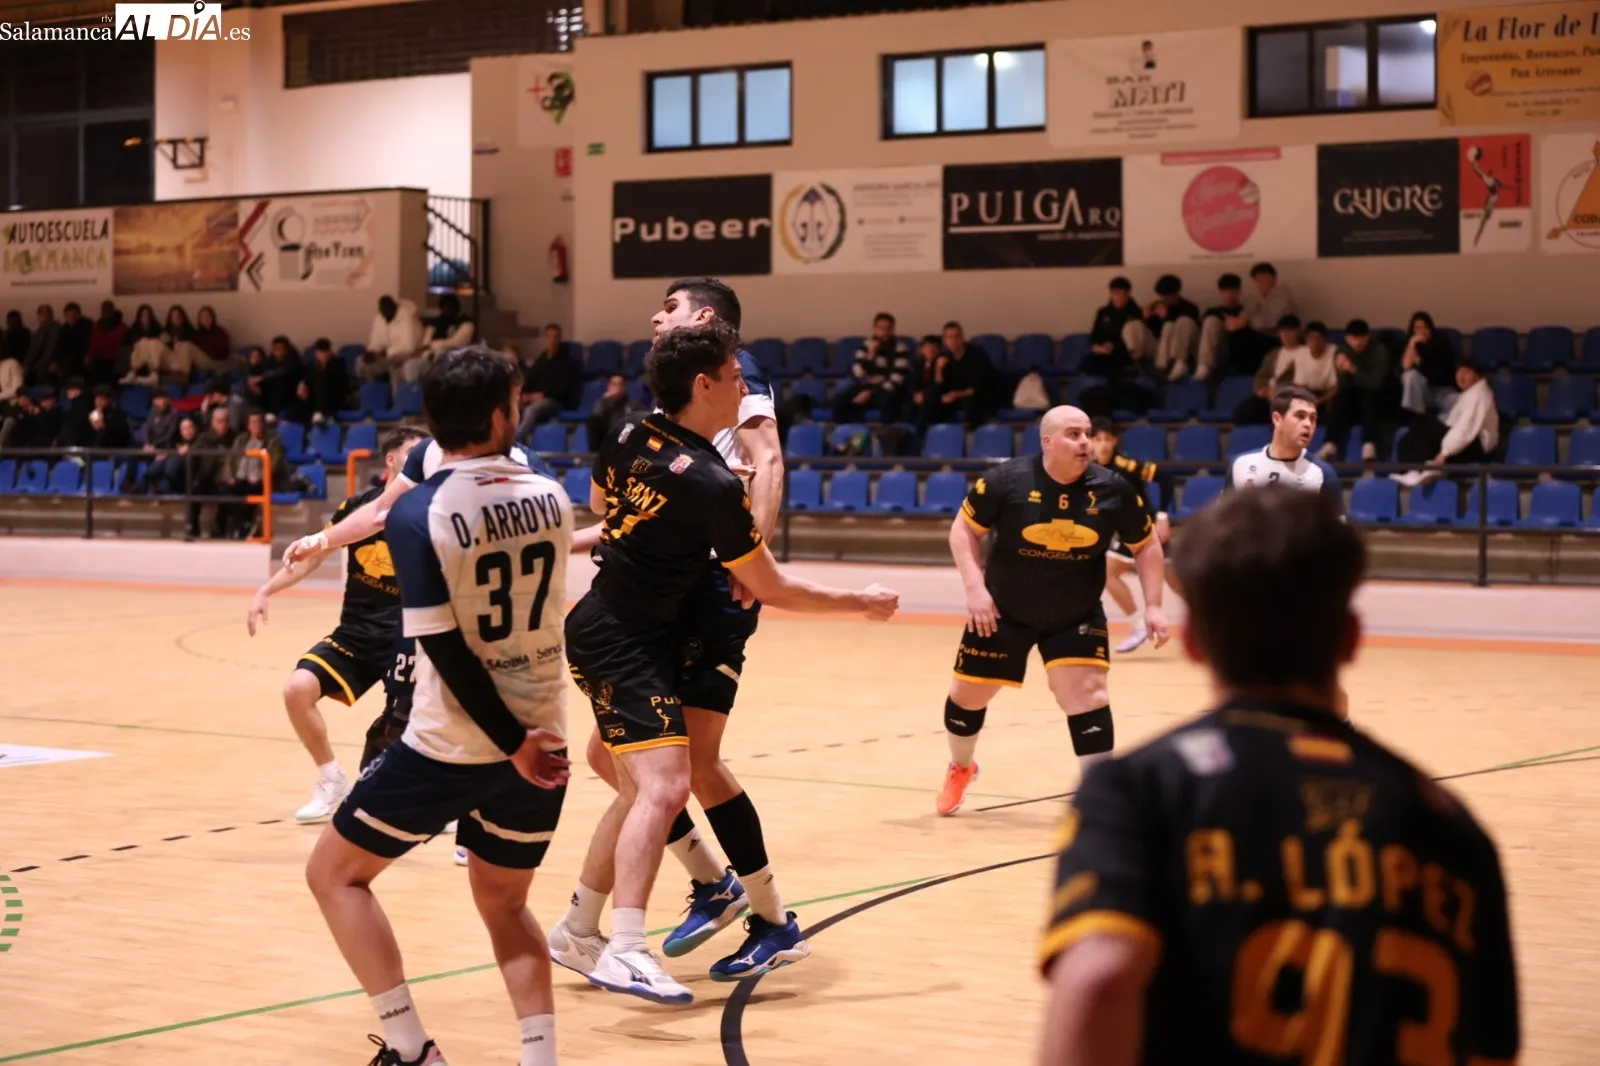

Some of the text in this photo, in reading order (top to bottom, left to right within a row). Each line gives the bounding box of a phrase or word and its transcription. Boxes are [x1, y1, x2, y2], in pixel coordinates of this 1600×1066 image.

[1463, 20, 1488, 42] La
[1498, 16, 1546, 41] Flor
[1554, 13, 1582, 37] de
[8, 217, 109, 245] AUTOESCUELA
[613, 215, 772, 244] Pubeer
[622, 476, 669, 516] SANZ
[1058, 493, 1070, 510] 6
[450, 492, 563, 550] O. ARROYO
[475, 540, 556, 643] 37
[959, 642, 1009, 660] Pubeer
[1185, 817, 1478, 952] A. LÓPEZ
[380, 1005, 411, 1020] adidas
